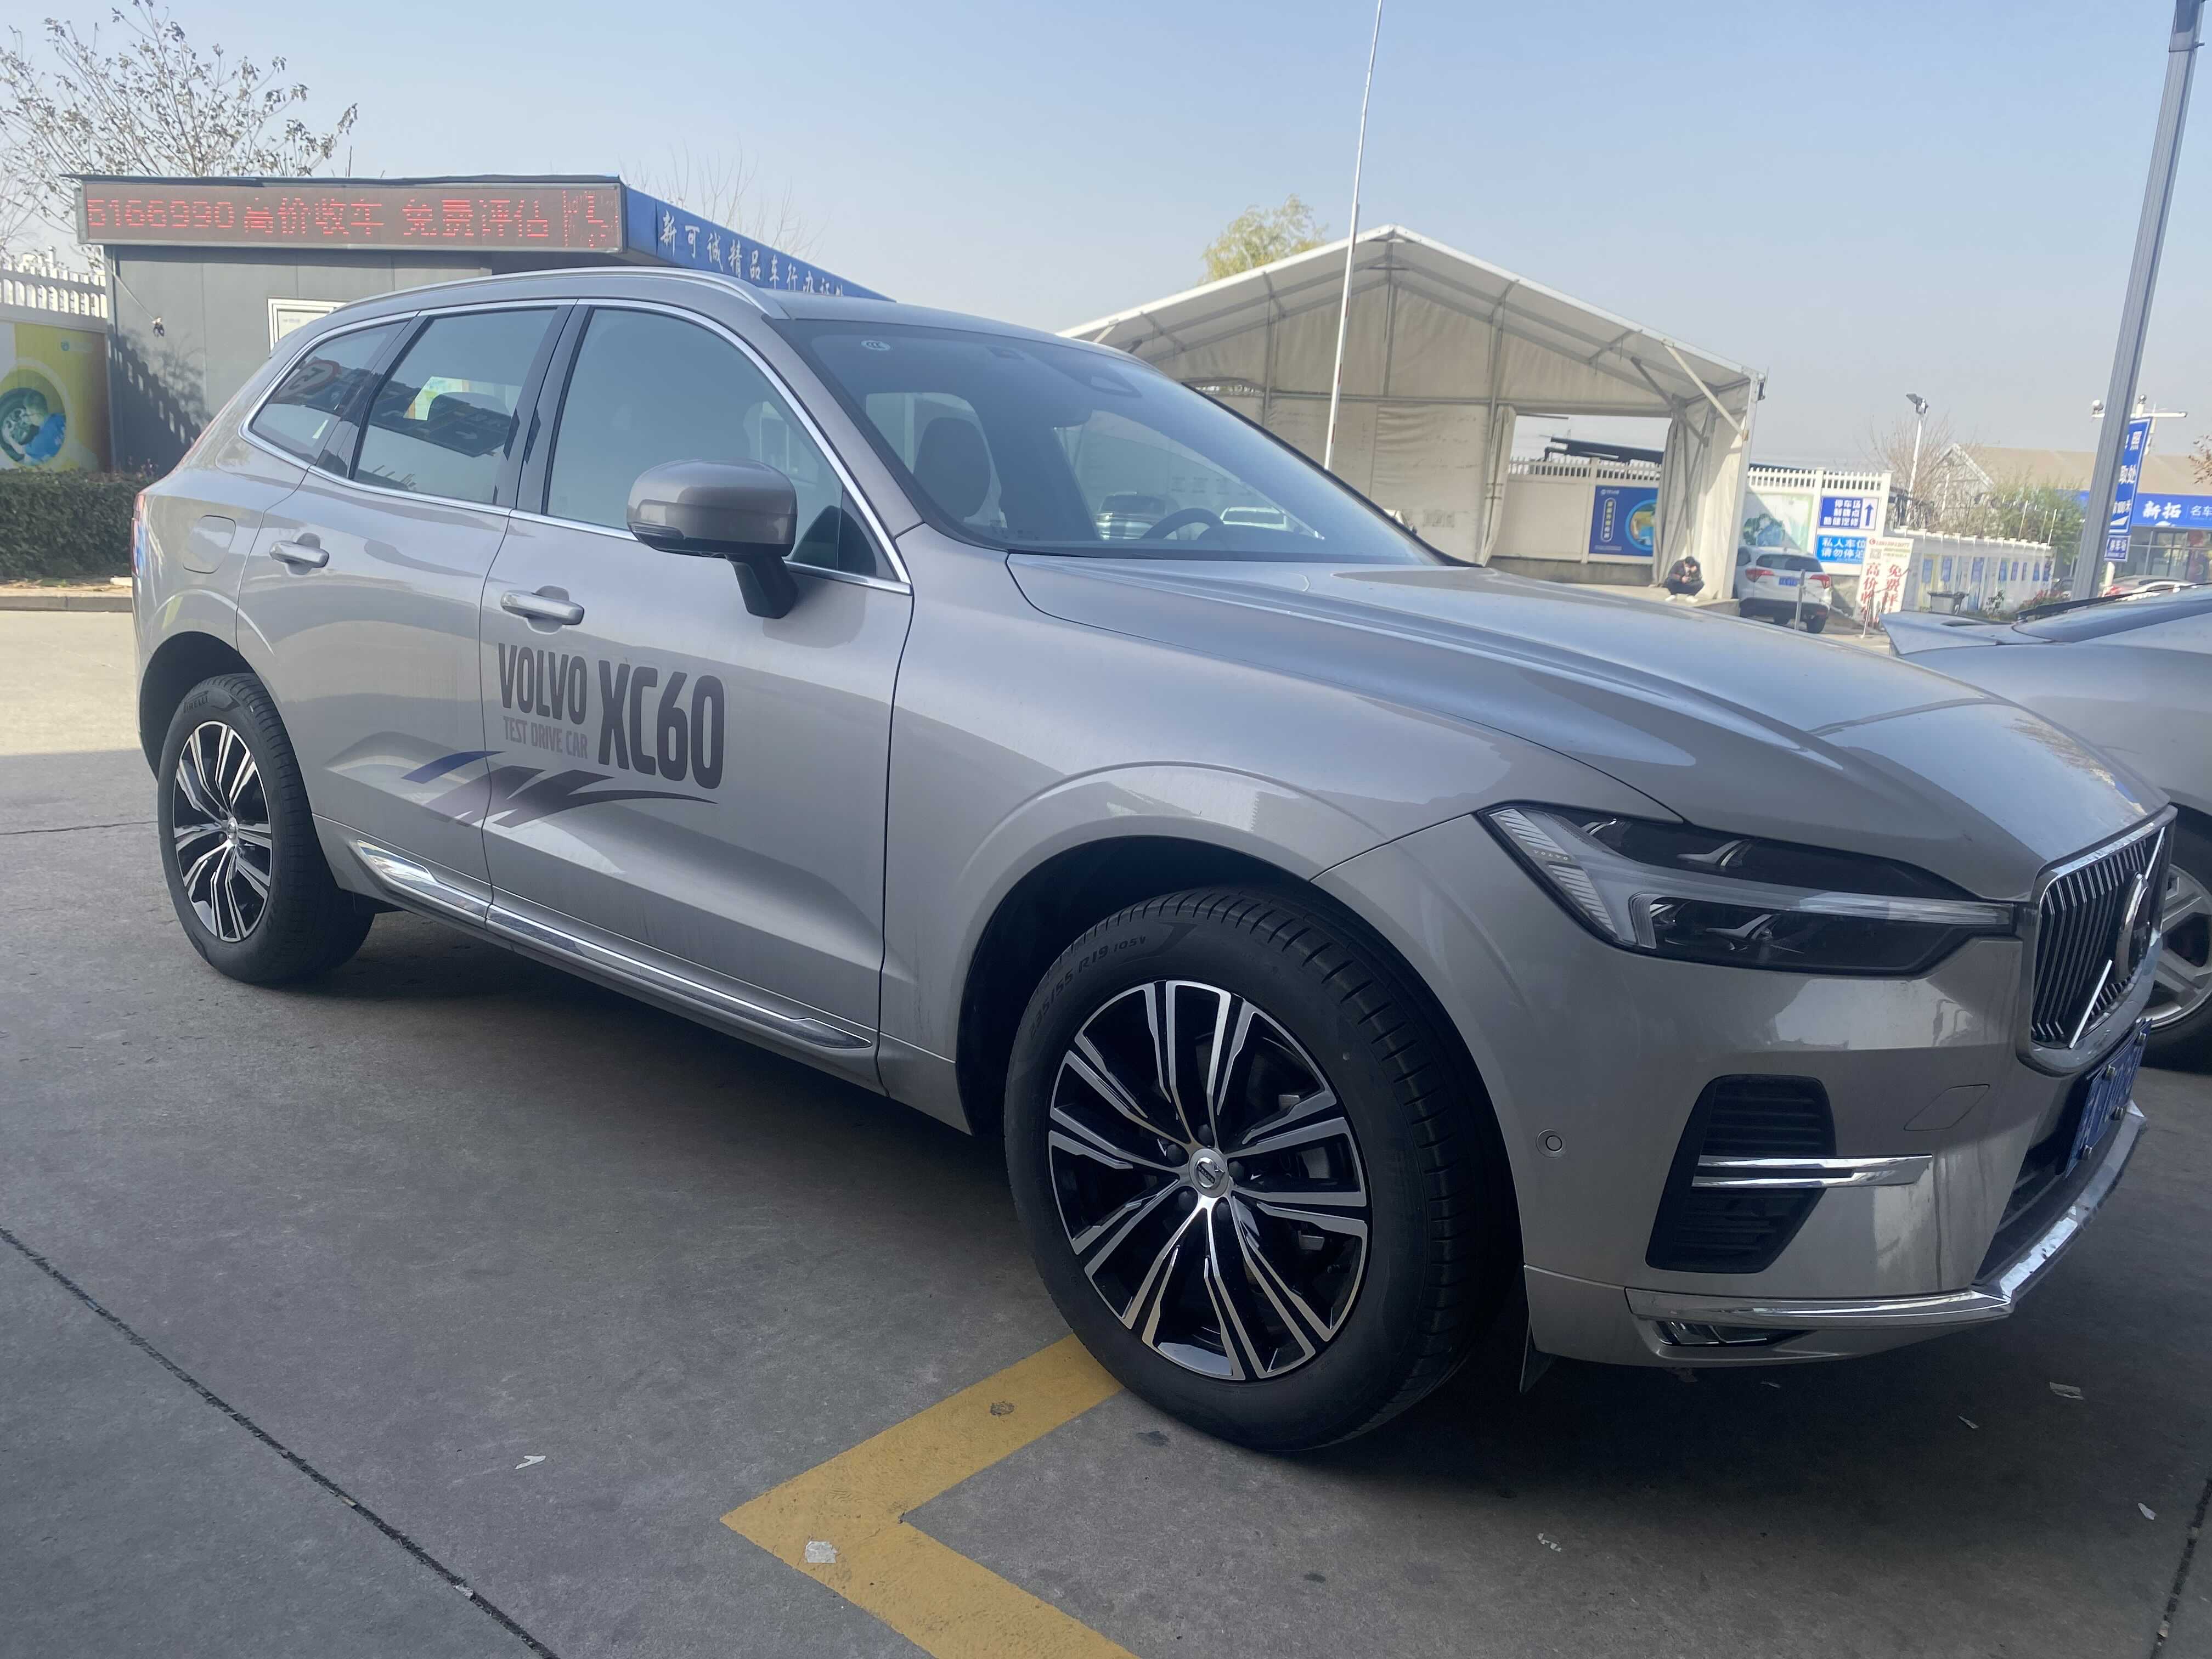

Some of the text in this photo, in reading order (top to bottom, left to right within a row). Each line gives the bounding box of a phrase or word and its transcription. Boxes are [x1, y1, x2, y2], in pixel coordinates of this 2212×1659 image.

[1822, 538, 1866, 549] 私人车位
[183, 690, 210, 713] PIRELLI
[498, 642, 725, 789] VOLVO XC60
[503, 716, 588, 759] TEST DRIVE CAR
[1533, 850, 1568, 860] VOLVO
[1078, 945, 1110, 974] R19
[1113, 935, 1147, 953] 105V
